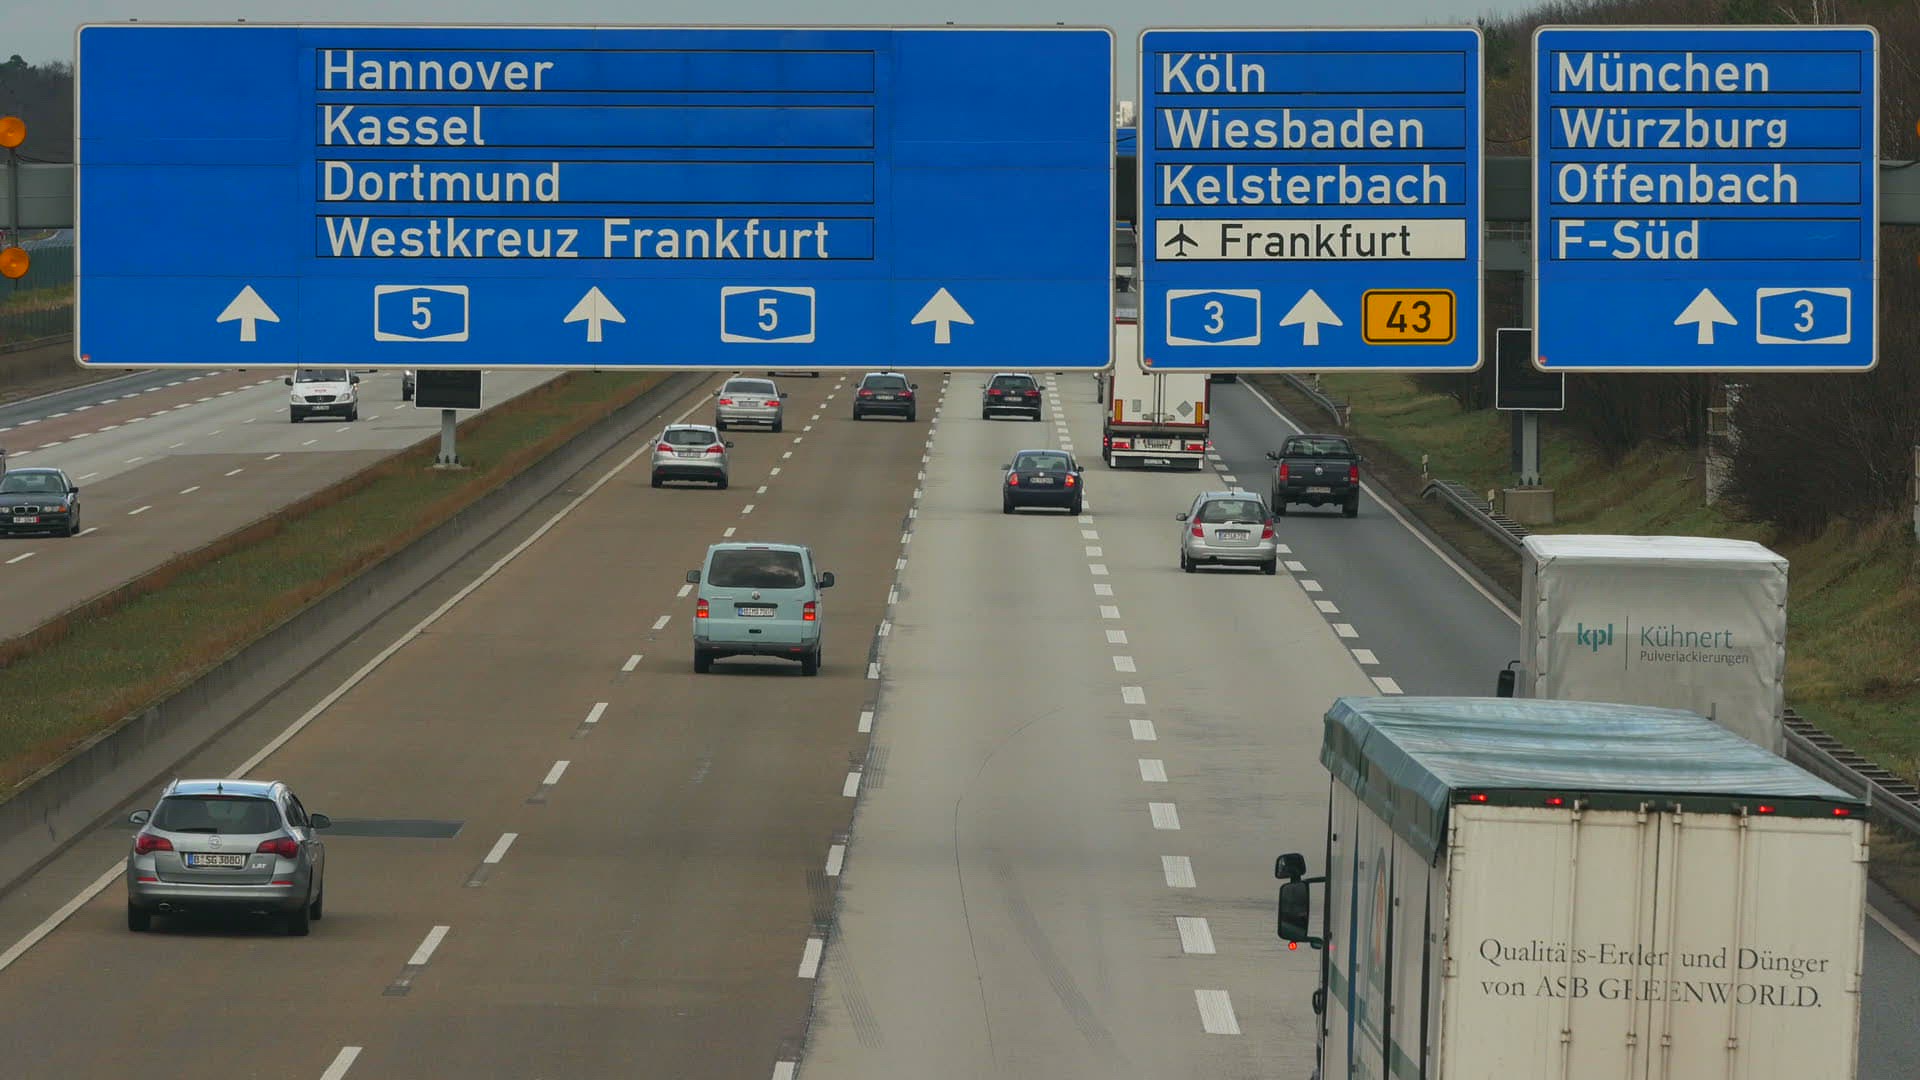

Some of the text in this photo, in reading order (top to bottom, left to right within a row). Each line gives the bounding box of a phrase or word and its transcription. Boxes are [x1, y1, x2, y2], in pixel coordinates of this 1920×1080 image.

[325, 50, 553, 90] Hannover
[1163, 53, 1265, 92] Köln
[1559, 52, 1769, 91] München
[325, 106, 485, 145] Kassel
[1165, 109, 1424, 148] Wiesbaden
[1560, 108, 1787, 148] Würzburg
[325, 161, 560, 202] Dortmund
[1163, 165, 1447, 204] Kelsterbach
[1559, 164, 1798, 204] Offenbach
[325, 217, 829, 258] Westkreuz Frankfurt
[1221, 223, 1411, 258] Frankfurt
[1559, 220, 1699, 260] F-Süd
[411, 297, 431, 330] 5
[758, 298, 778, 332] 5
[1204, 301, 1224, 334] 3
[1385, 301, 1432, 334] 43
[1794, 299, 1814, 333] 3
[1577, 622, 1613, 652] kpl
[1640, 625, 1733, 649] Kühnert
[1640, 650, 1749, 666] Pulverlackierungen
[1682, 947, 1727, 969] und
[1738, 947, 1829, 980] Dünger
[1481, 979, 1526, 997] von
[1536, 974, 1590, 999] ASB
